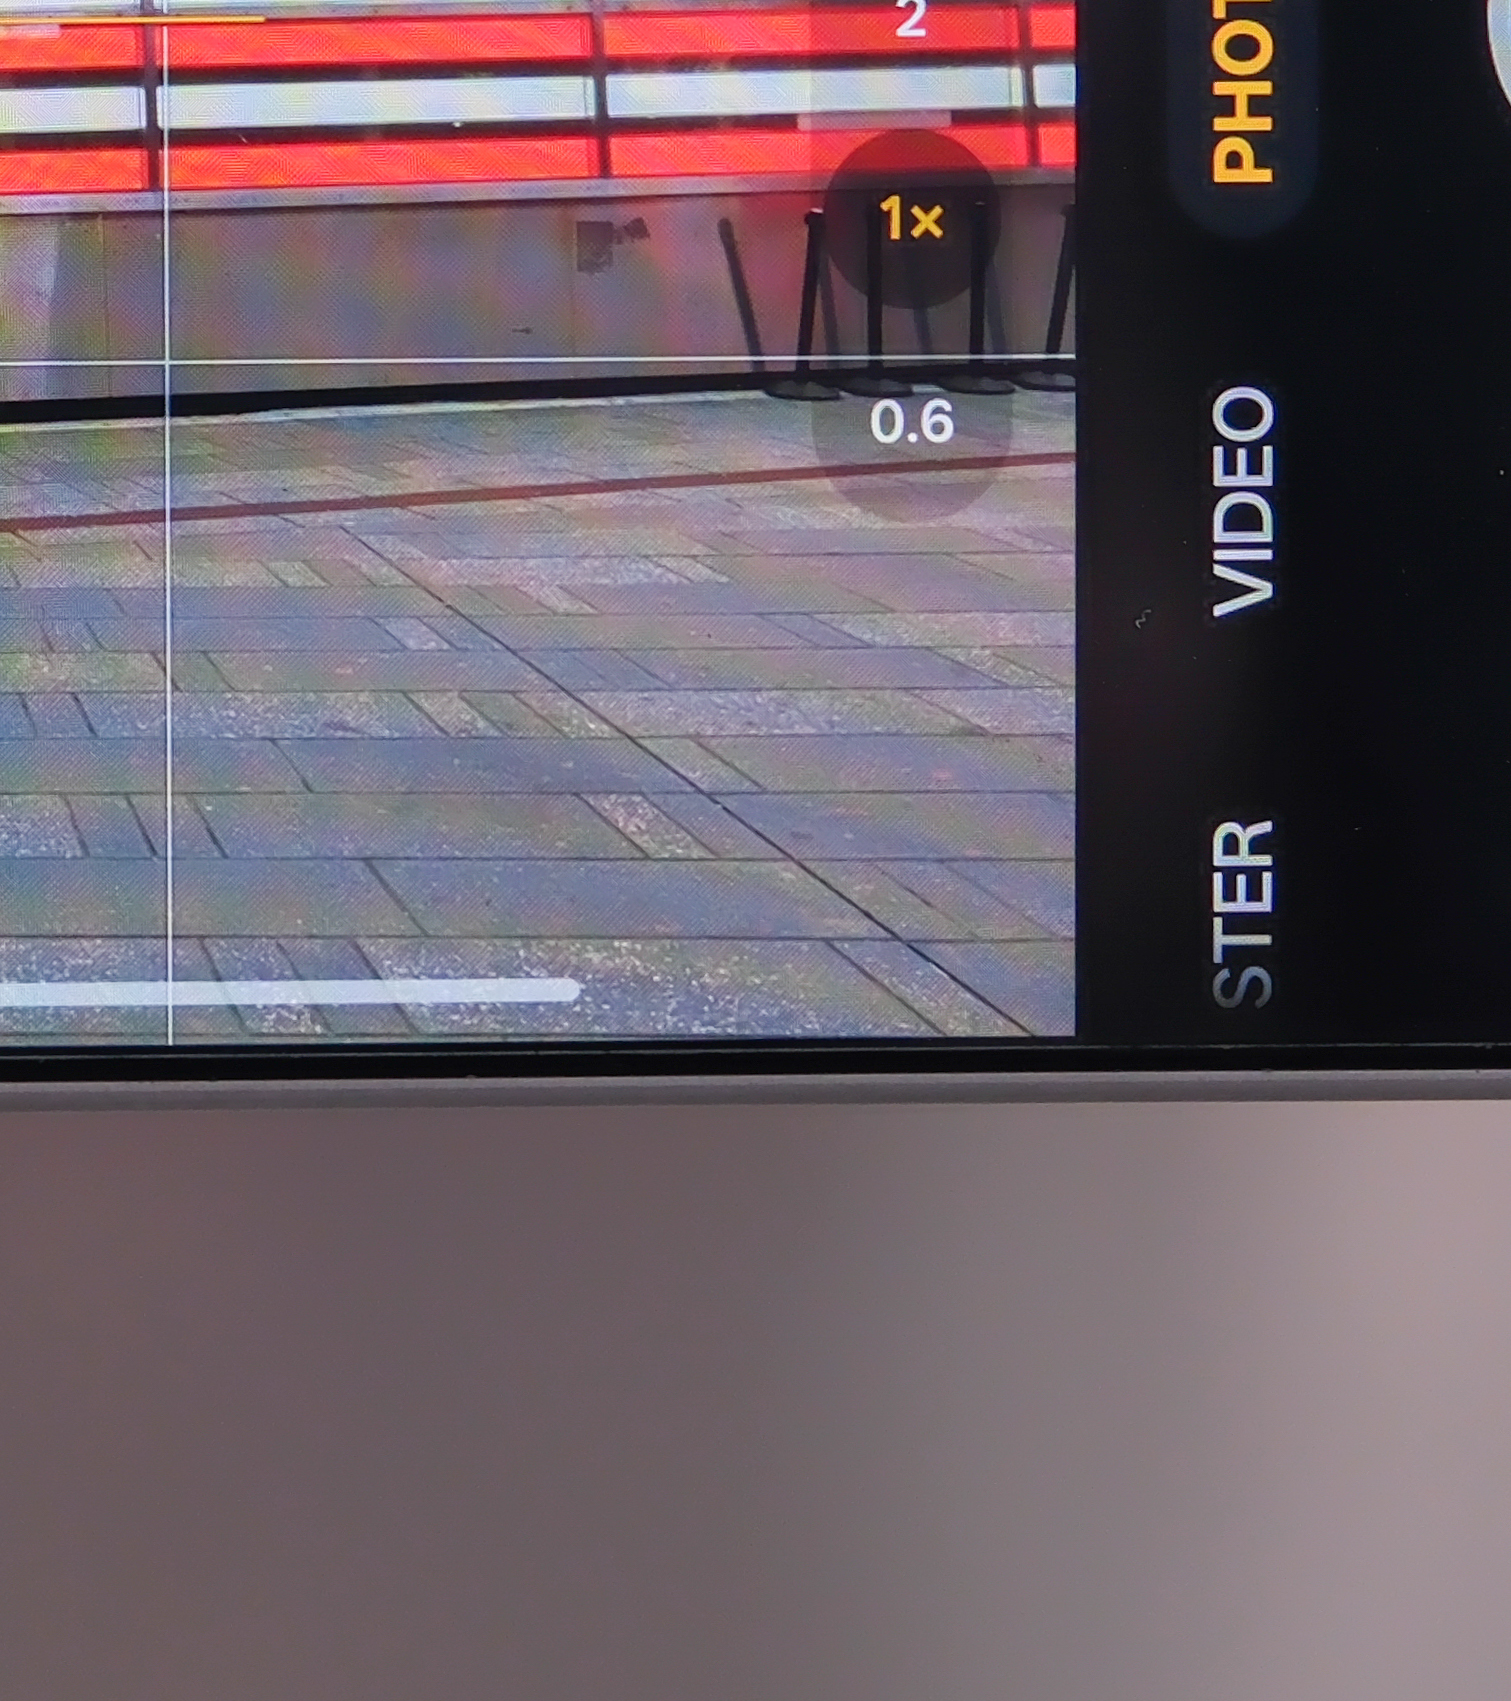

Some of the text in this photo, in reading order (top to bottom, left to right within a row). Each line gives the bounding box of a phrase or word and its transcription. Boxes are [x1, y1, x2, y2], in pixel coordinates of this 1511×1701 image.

[870, 398, 955, 443] 0.6
[1213, 385, 1274, 617] VIDEO
[1212, 820, 1274, 1009] STER
